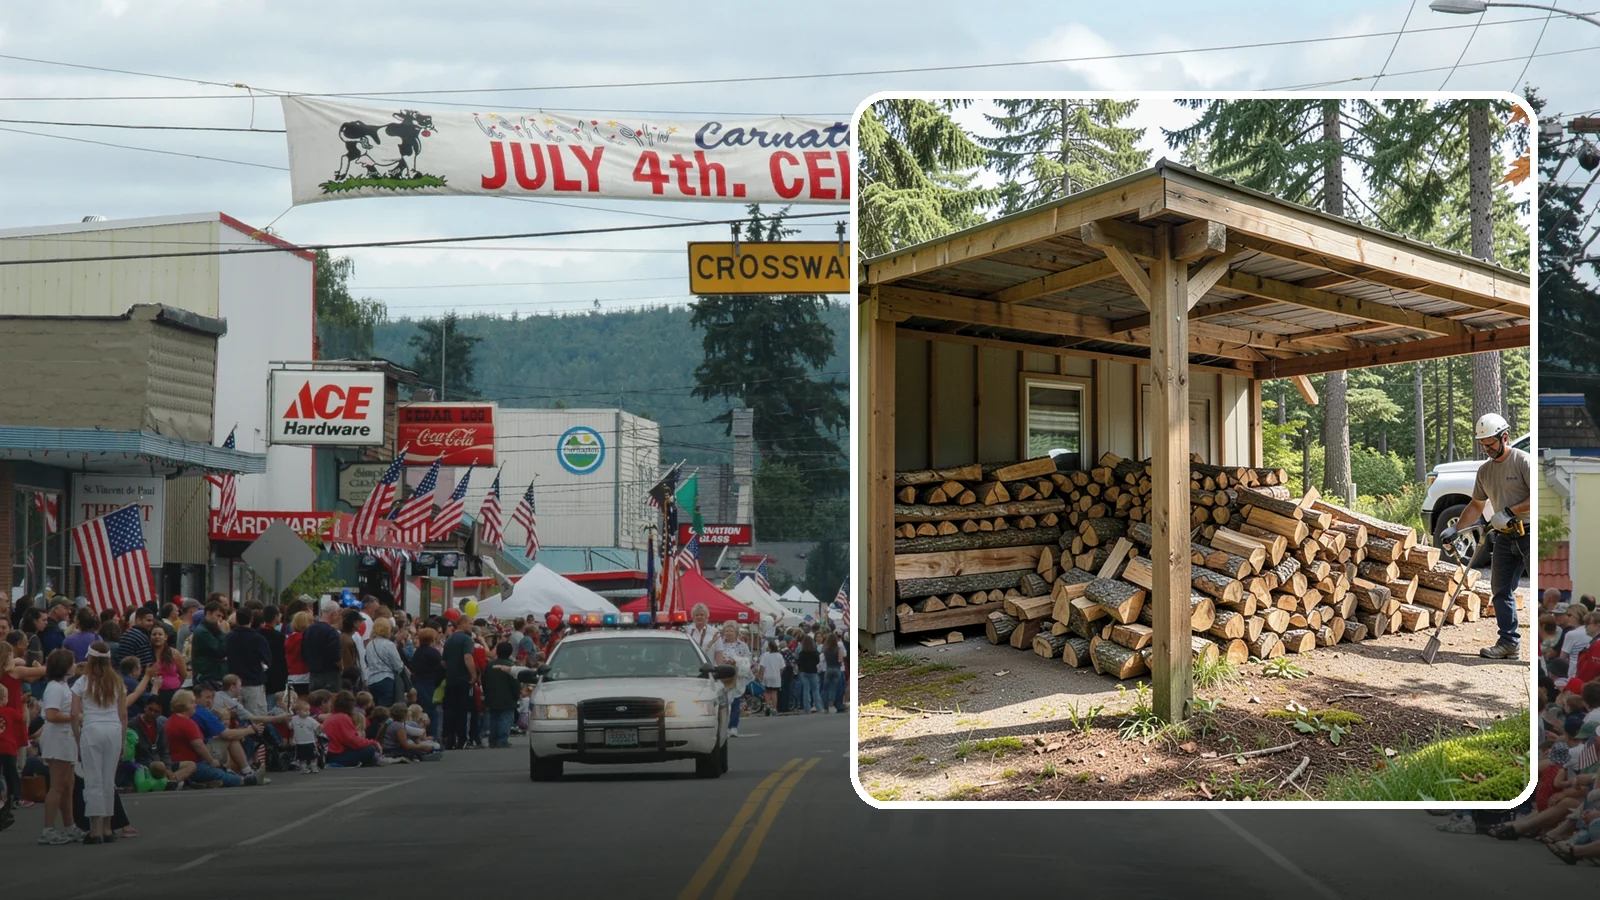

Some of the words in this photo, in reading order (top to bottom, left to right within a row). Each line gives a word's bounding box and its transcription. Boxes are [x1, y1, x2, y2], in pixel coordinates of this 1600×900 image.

[481, 141, 604, 192] JULY
[632, 149, 746, 197] 4th.
[696, 254, 850, 280] CROSSWA
[283, 380, 373, 419] ACE
[405, 410, 452, 422] CEDAR
[283, 421, 371, 436] Hardware
[96, 486, 124, 494] Vincent
[126, 486, 136, 494] de
[138, 486, 155, 495] Paul
[699, 535, 730, 543] GLASS
